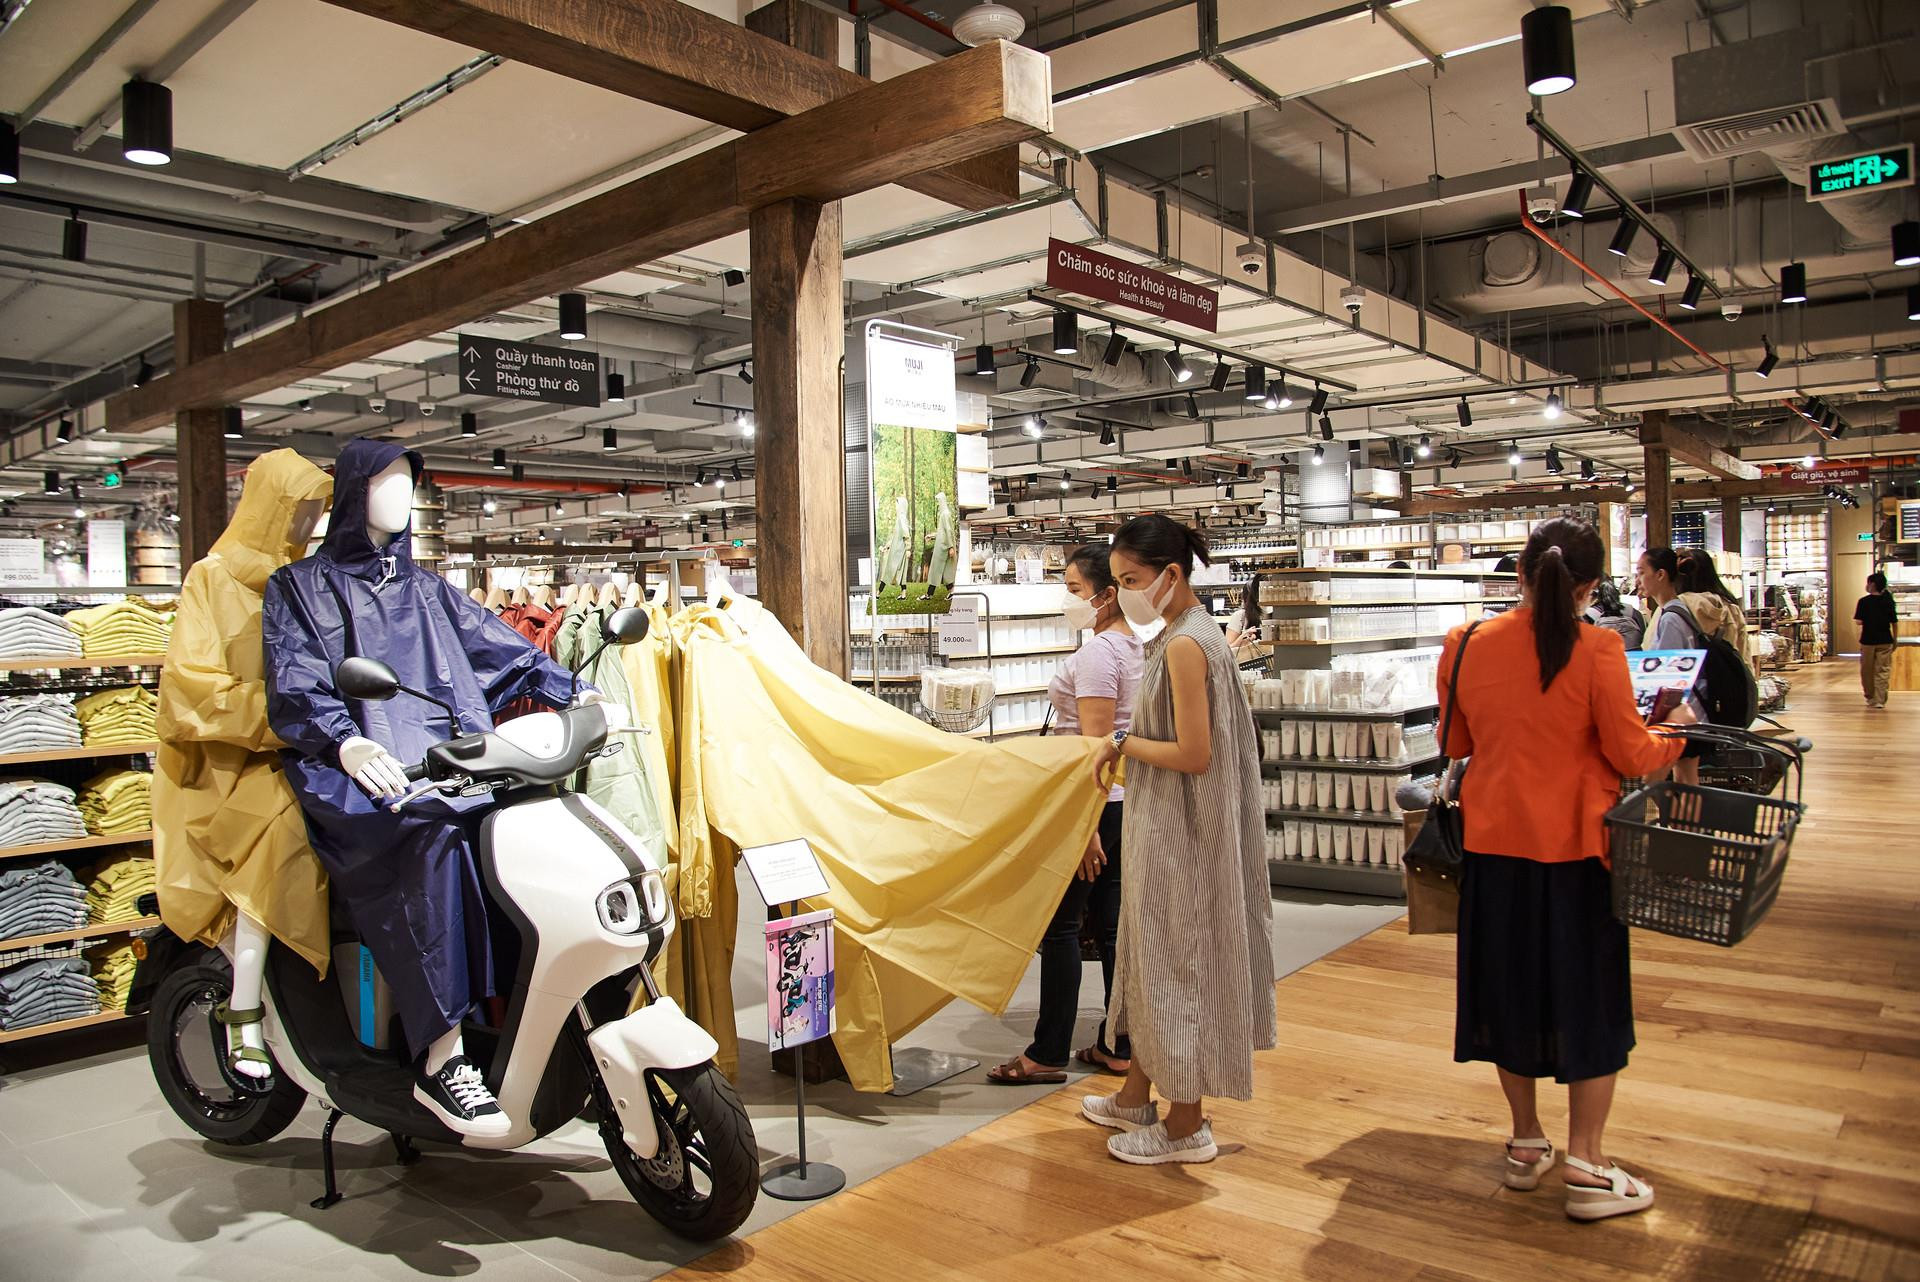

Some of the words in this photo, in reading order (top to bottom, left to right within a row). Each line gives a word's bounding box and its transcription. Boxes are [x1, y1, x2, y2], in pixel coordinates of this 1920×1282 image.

[1821, 176, 1852, 191] EXIT
[1057, 250, 1092, 274] Chăm
[1095, 262, 1115, 280] sóc
[1117, 270, 1139, 287] sức
[1166, 285, 1178, 300] và
[1179, 287, 1195, 305] làm
[1197, 295, 1213, 314] đẹp
[1119, 289, 1139, 303] Health
[1140, 295, 1144, 305] &
[1145, 299, 1165, 312] Beauty
[495, 347, 529, 366] Quầy
[531, 353, 566, 368] thanh
[569, 358, 595, 372] toán
[495, 362, 521, 371] Cashier
[904, 357, 924, 370] MUJI
[496, 371, 536, 390] Phòng
[540, 376, 561, 390] thử
[564, 378, 580, 393] đồ
[497, 385, 519, 395] Fitting
[520, 387, 541, 397] Room
[1791, 472, 1809, 481] Giặt
